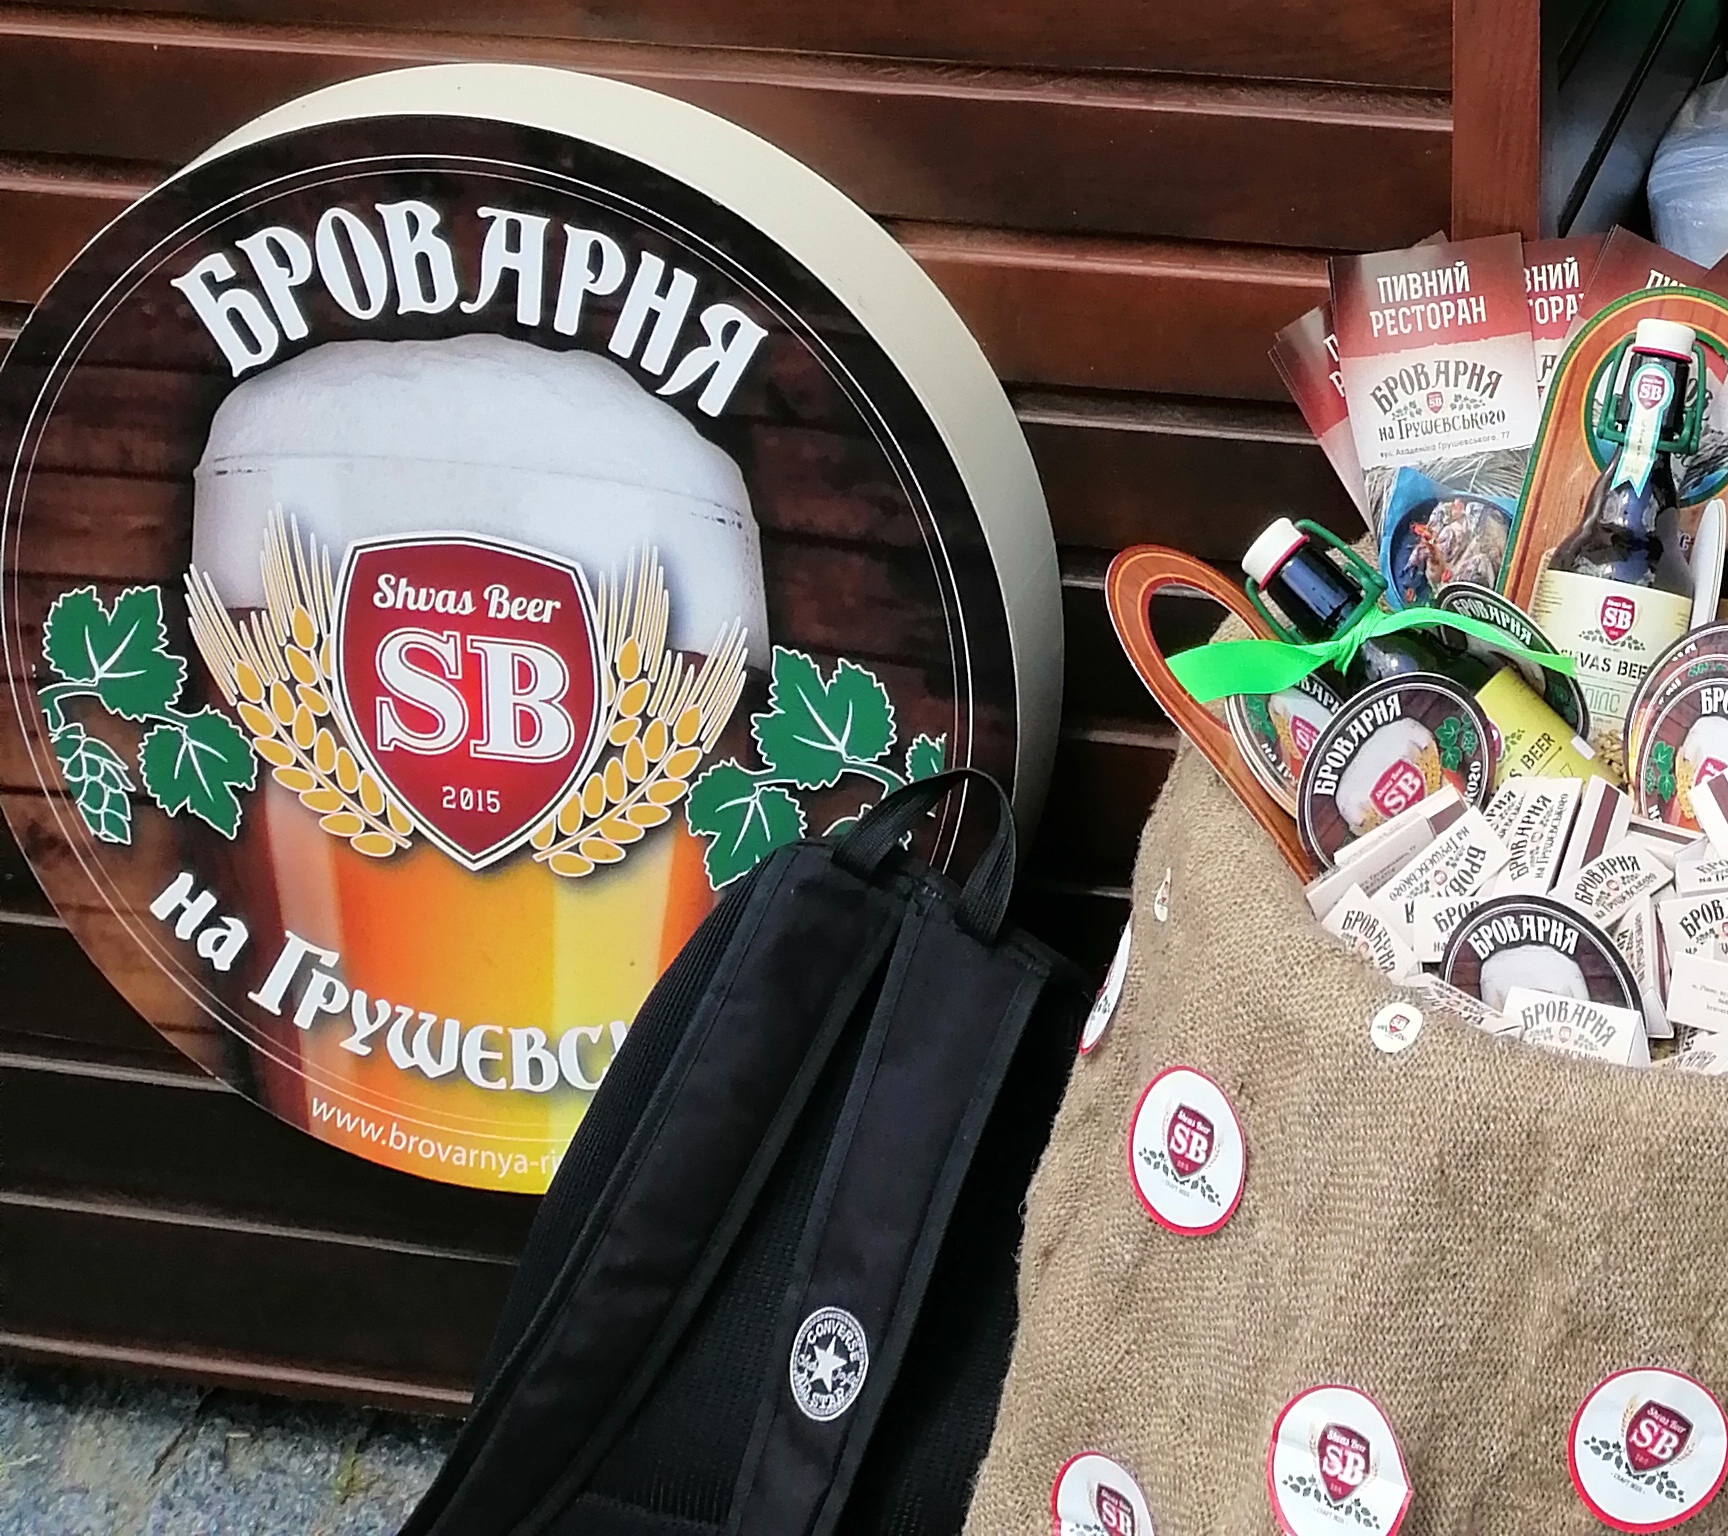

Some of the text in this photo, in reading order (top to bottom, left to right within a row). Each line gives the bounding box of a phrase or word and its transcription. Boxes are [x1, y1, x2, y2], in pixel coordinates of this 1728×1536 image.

[1376, 259, 1471, 304] ПИВНИЙ
[170, 199, 769, 418] БРОВАРНЯ
[1369, 295, 1487, 338] РЕСТОРАН
[1369, 359, 1503, 416] БРОВАРНЯ
[1638, 383, 1665, 402] SB
[1378, 409, 1506, 442] на Грушевського
[372, 572, 562, 624] Shvas Beer
[1602, 606, 1633, 630] SB
[1617, 660, 1650, 680] BEE
[374, 626, 575, 764] SB
[1313, 692, 1402, 797] БРОВАРНЯ
[1520, 731, 1556, 771] BEER
[441, 785, 502, 814] 2015
[1383, 770, 1423, 816] SB
[1509, 794, 1553, 882] БРОВАРНЯ
[1574, 854, 1642, 907] БРОВАРНЯ
[1341, 909, 1397, 973] БРОВАРНЯ
[1467, 914, 1580, 961] БРОВАРНЯ
[148, 871, 633, 1094] на Грушевс
[1520, 999, 1617, 1047] БРОВАРНЯ
[1169, 1122, 1209, 1164] SB
[806, 1319, 861, 1362] CONVERSE
[810, 1387, 846, 1409] STAR
[1629, 1417, 1681, 1461] SB
[1321, 1443, 1367, 1486] SB
